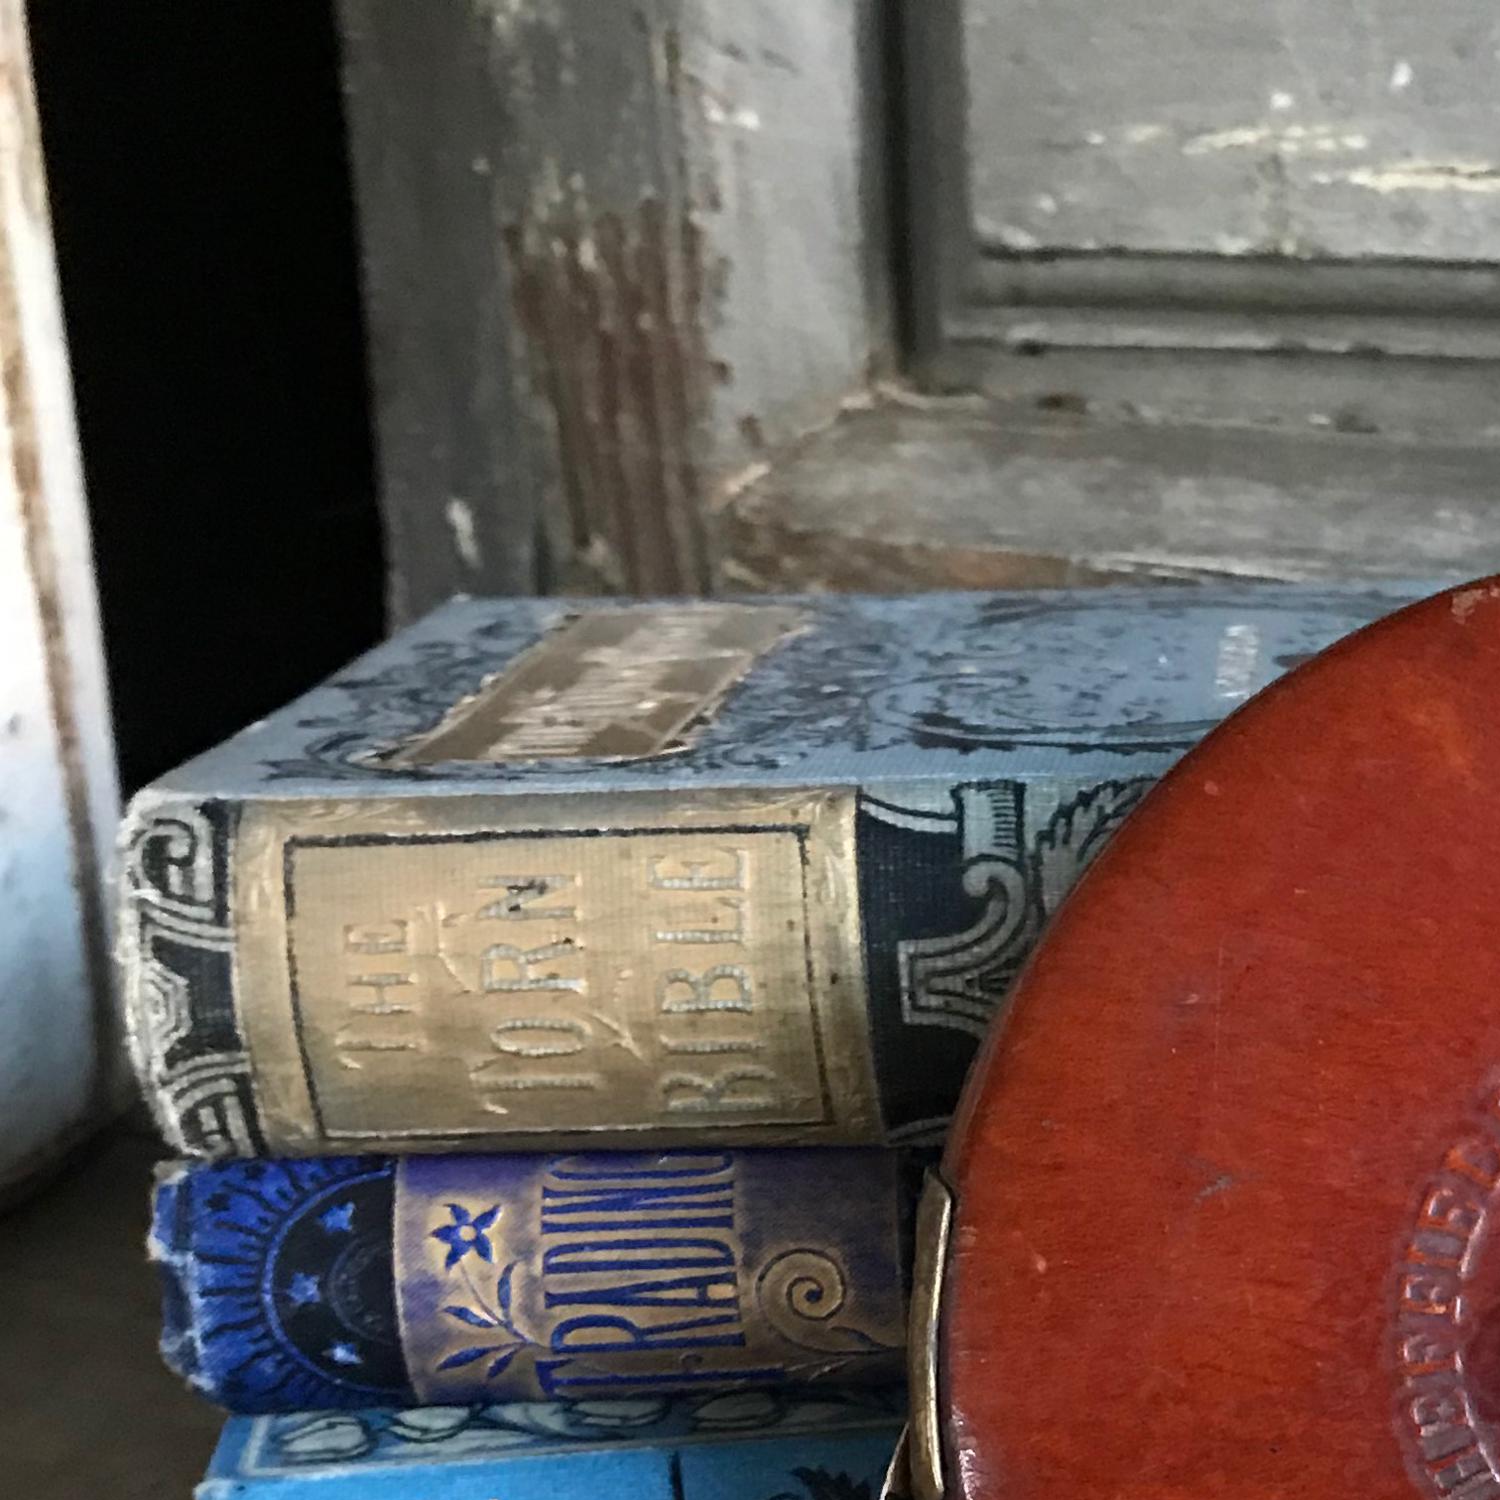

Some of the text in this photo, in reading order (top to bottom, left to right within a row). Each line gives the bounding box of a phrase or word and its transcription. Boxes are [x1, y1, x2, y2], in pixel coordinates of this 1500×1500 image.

[334, 918, 428, 1070] THE
[468, 873, 600, 1114] TORN
[648, 846, 775, 1112] BIBLE
